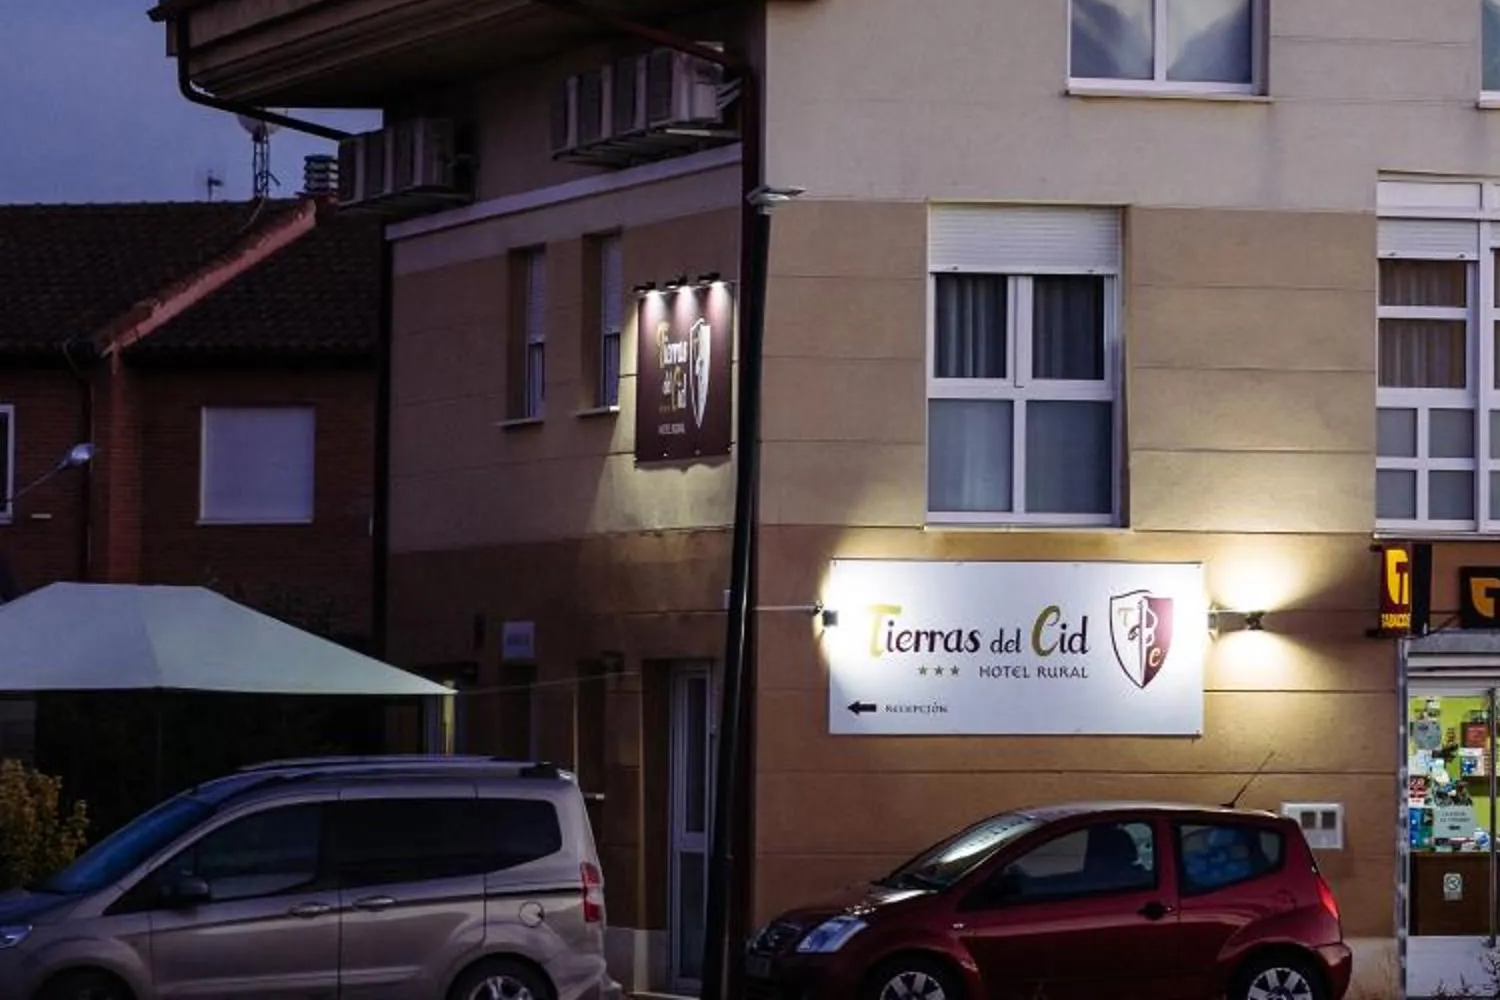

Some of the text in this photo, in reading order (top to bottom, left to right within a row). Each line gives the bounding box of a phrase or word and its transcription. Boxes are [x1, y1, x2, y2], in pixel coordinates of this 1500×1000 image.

[867, 603, 1089, 658] Tierras del Cid
[978, 665, 1089, 679] HOTEL RURAL
